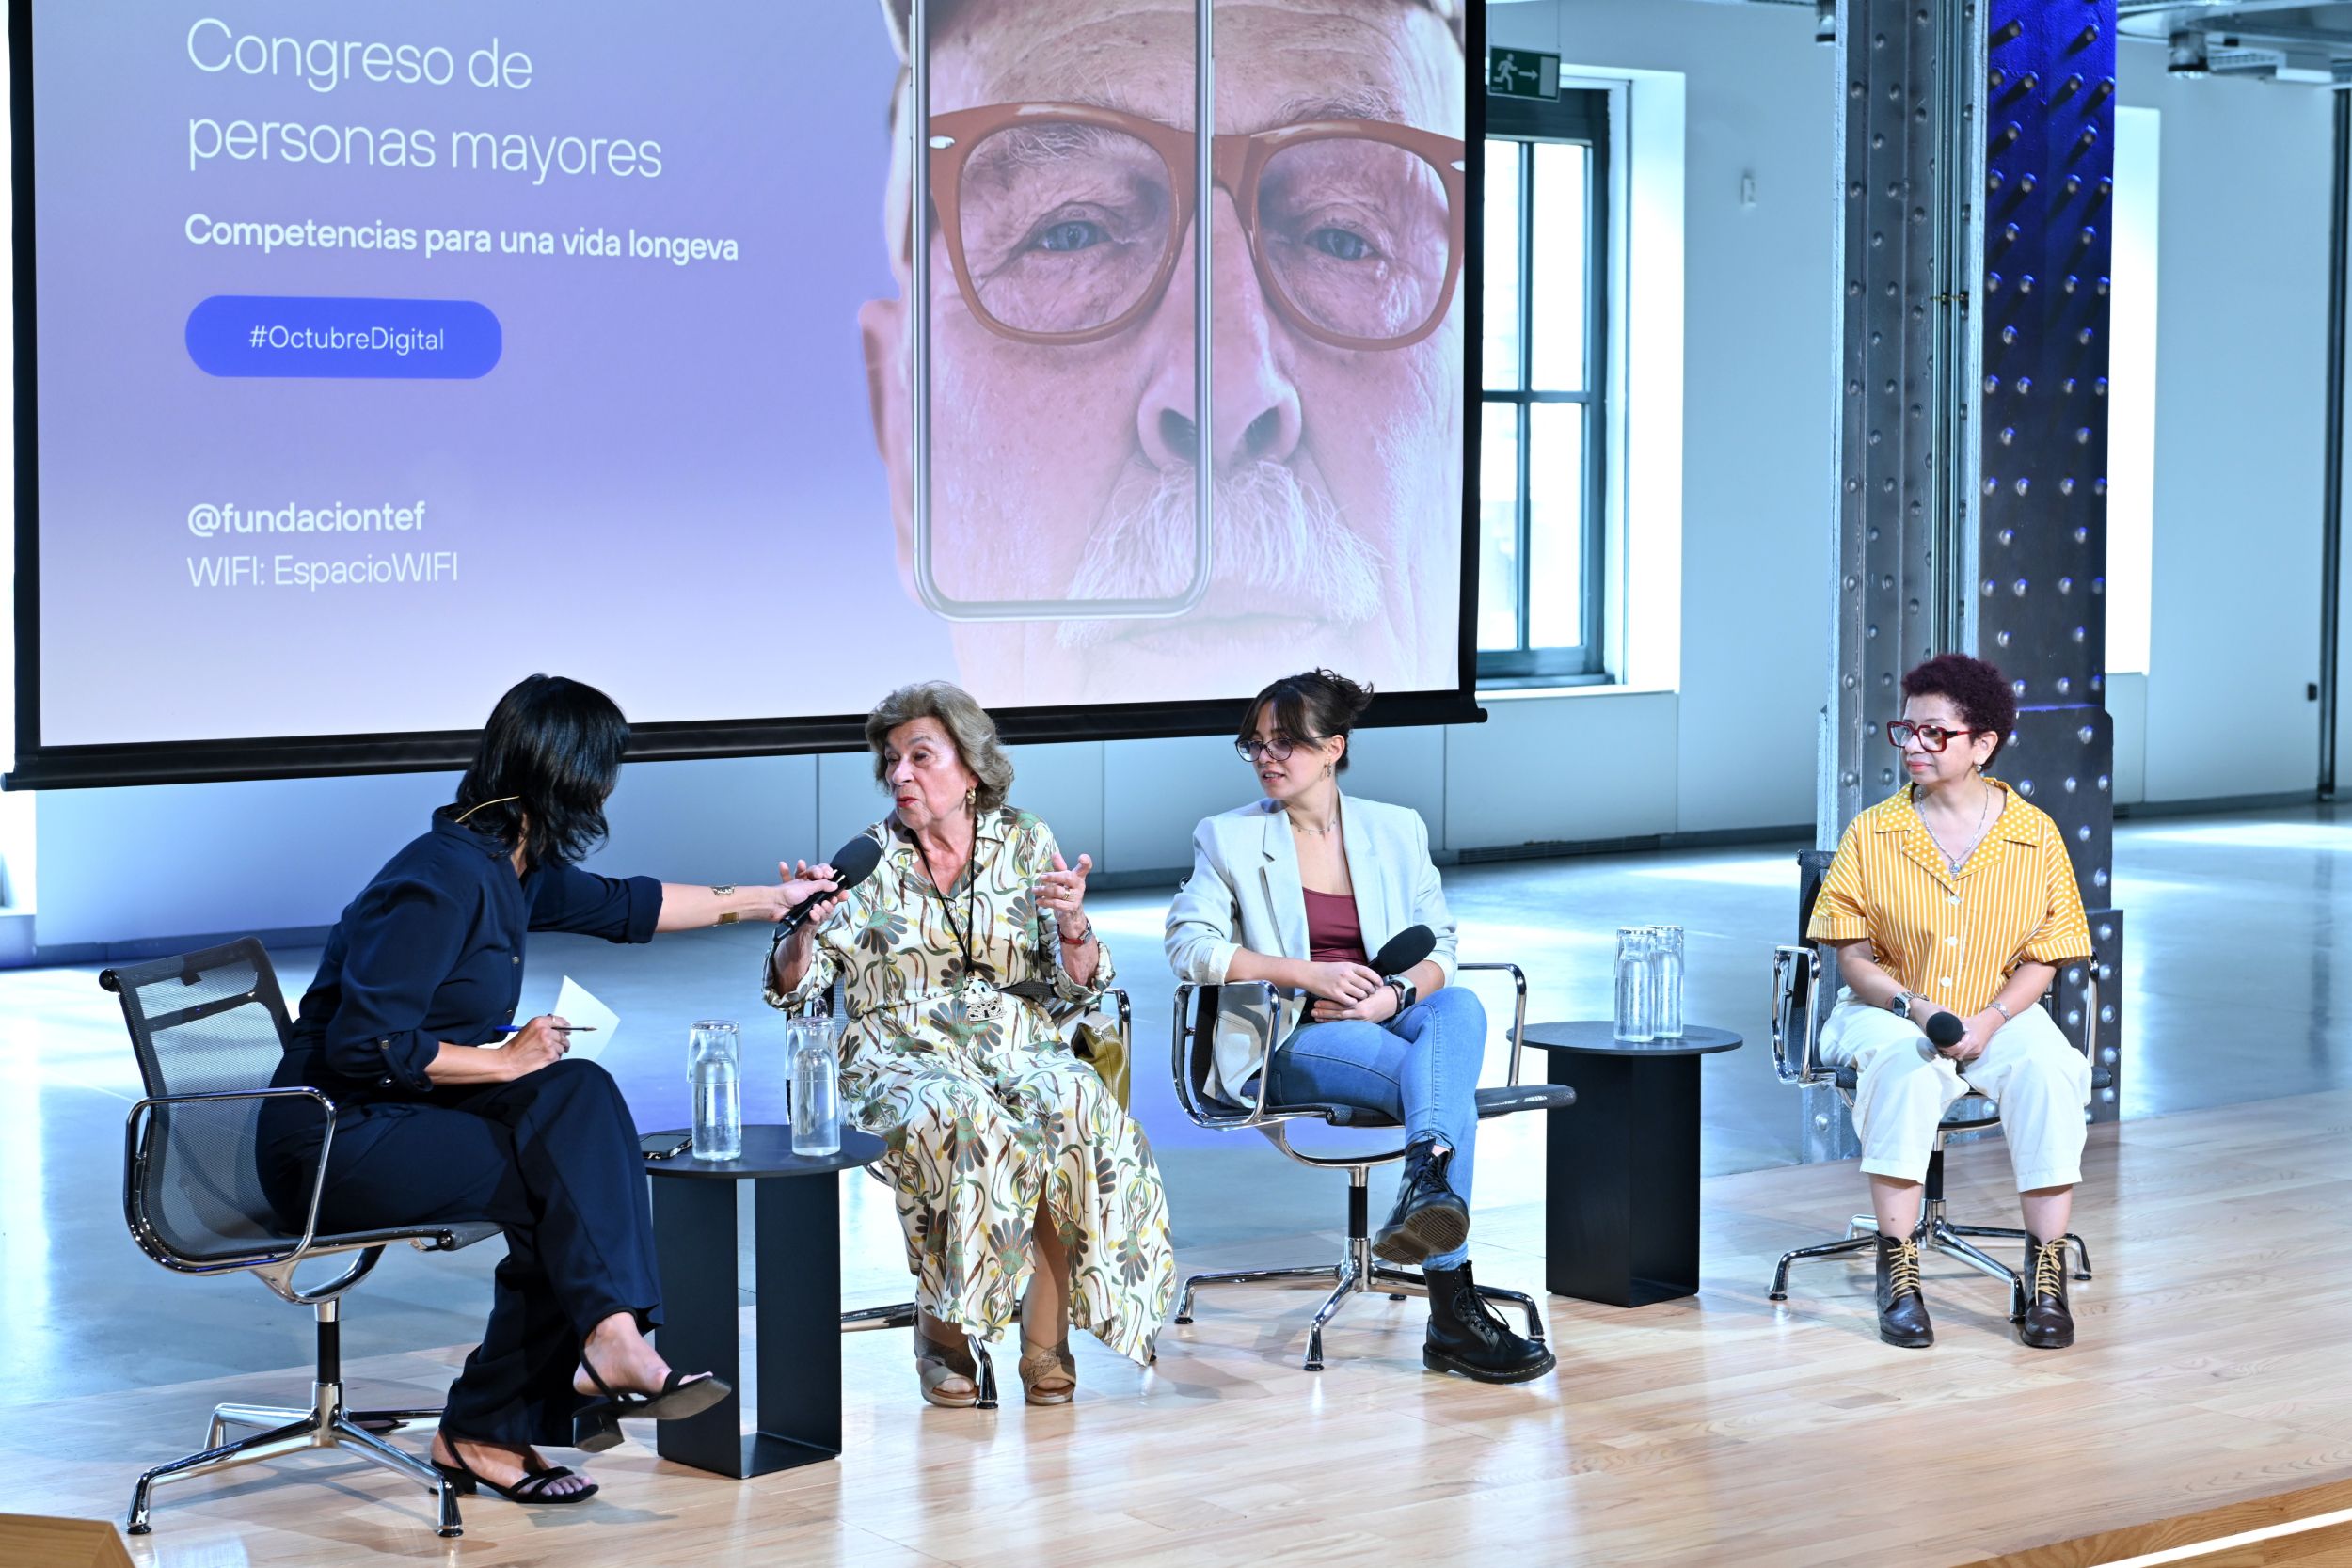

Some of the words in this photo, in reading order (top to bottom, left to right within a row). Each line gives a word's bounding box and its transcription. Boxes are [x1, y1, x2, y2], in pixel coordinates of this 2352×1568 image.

[187, 17, 454, 93] Congreso
[468, 37, 533, 90] de
[189, 118, 437, 172] personas
[452, 130, 663, 186] mayores
[184, 213, 418, 254] Competencias
[425, 229, 492, 259] para
[500, 231, 554, 255] una
[561, 226, 621, 257] vida
[628, 229, 739, 266] longeva
[248, 324, 444, 356] #OctubreDigital
[187, 500, 426, 537] @fundaciontef
[186, 555, 266, 588] WIFI:
[275, 551, 458, 592] EspacioWIFI
